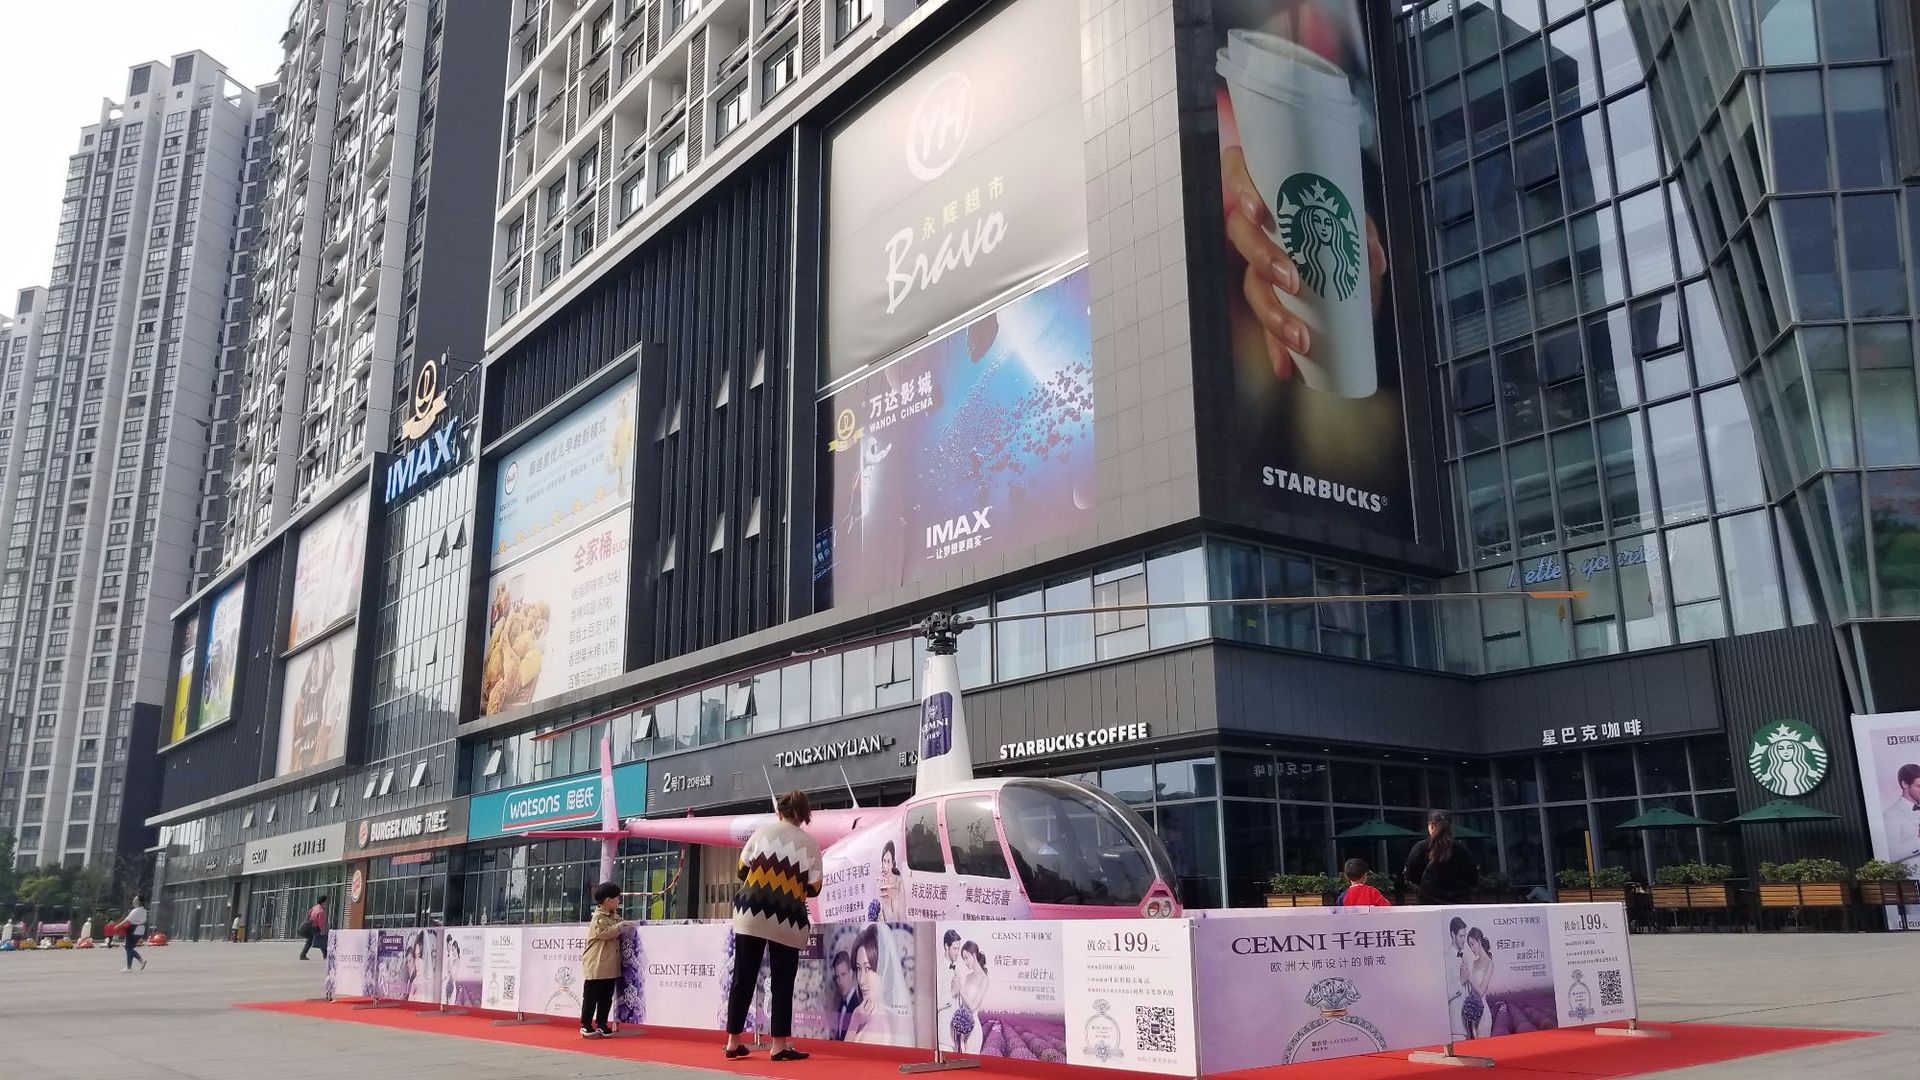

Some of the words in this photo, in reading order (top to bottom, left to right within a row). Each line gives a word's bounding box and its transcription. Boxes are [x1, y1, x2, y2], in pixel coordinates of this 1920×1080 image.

[921, 175, 1005, 242] 永辉超市
[884, 211, 1008, 314] Bravo
[869, 371, 933, 420] 万达影城
[869, 413, 897, 433] WANDA
[900, 397, 933, 420] CINEMA
[385, 415, 458, 503] IMAX
[1262, 466, 1382, 513] STARBUCKS
[926, 506, 993, 548] IMAX
[573, 530, 613, 573] 全家桶
[1000, 732, 1084, 760] STARBUCKS
[1088, 722, 1148, 757] COFFEE
[1542, 719, 1642, 746] 星巴克咖啡
[775, 734, 882, 768] TONGXINYUAN
[510, 794, 561, 819] watsons
[370, 817, 401, 842] BURGER
[400, 814, 423, 838] KING
[911, 883, 948, 901] 转发朋友圈
[965, 887, 1011, 906] 集赞送惊喜
[531, 938, 565, 950] CEMNI
[991, 932, 1022, 941] CEMNI
[1231, 933, 1328, 955] CEMNI
[1331, 929, 1416, 950] 千年珠宝
[648, 963, 681, 976] CEMNI
[682, 964, 716, 977] 千年珠宝
[1269, 955, 1387, 973] 欧洲大师设计的婚戒
